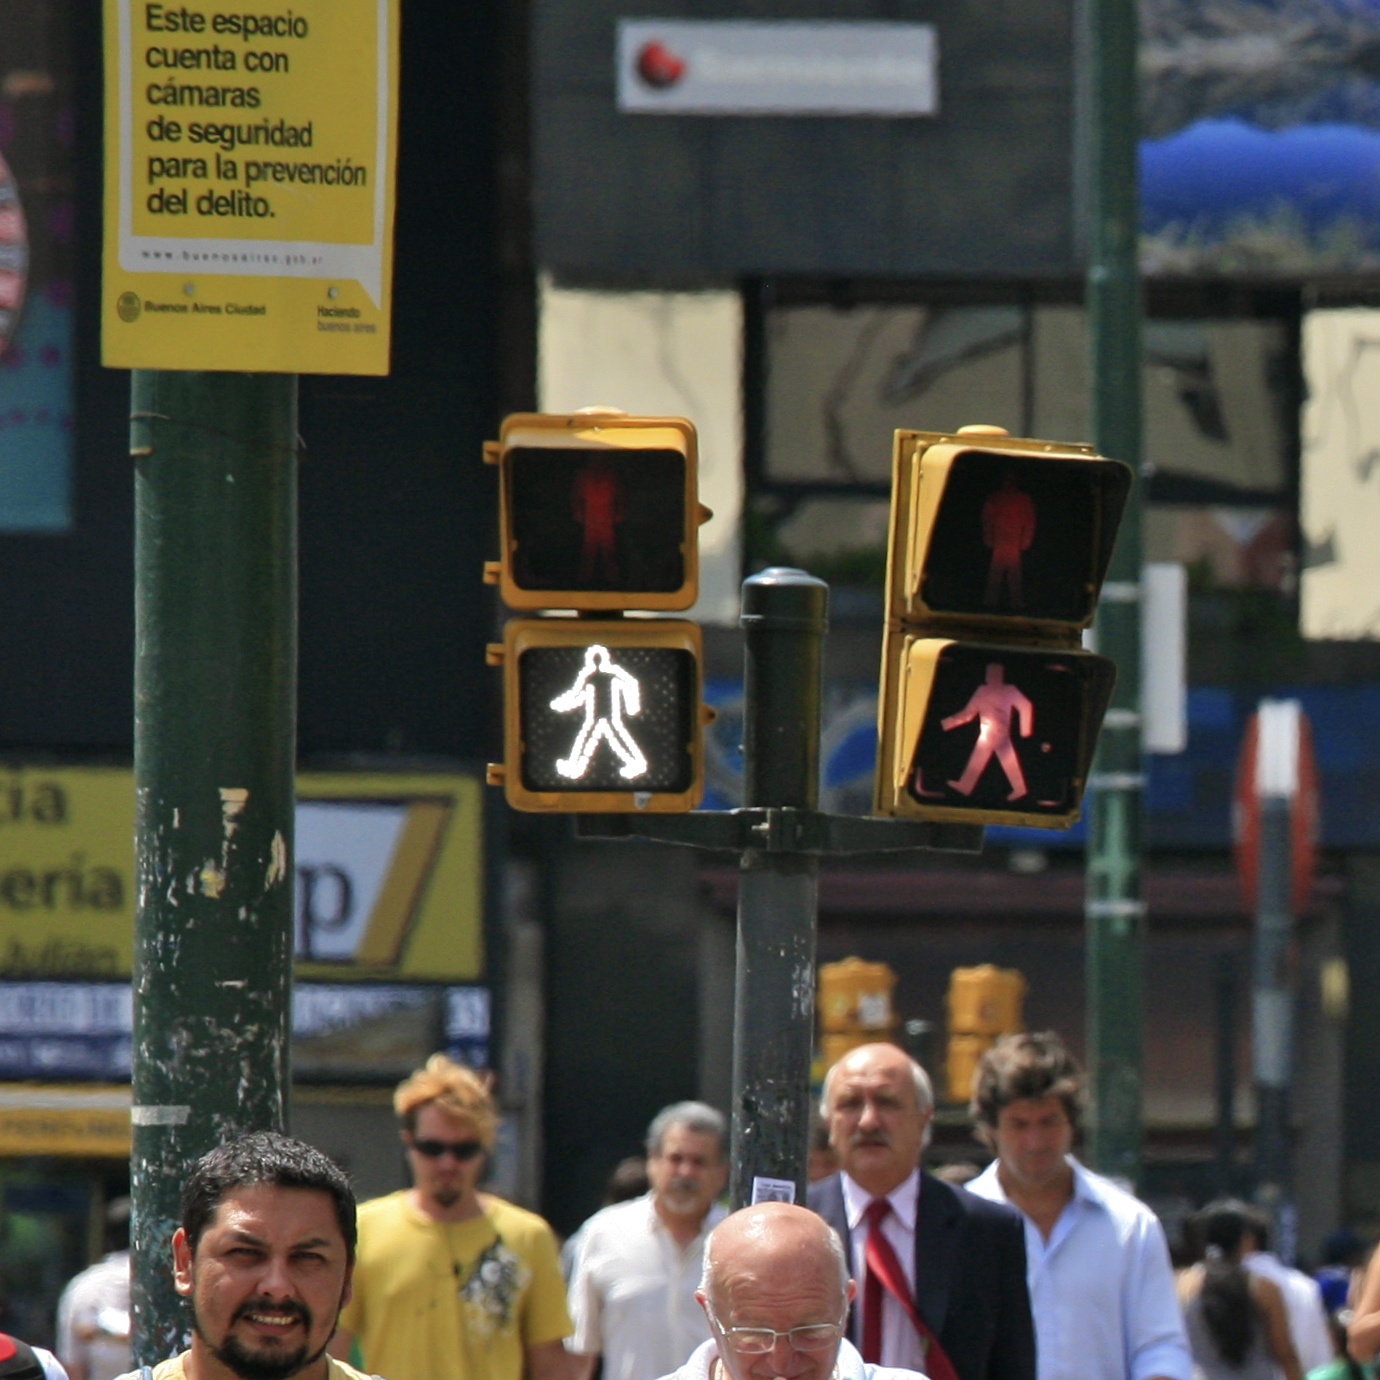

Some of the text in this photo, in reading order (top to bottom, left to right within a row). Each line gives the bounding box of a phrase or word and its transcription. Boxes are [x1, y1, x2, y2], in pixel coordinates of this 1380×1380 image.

[145, 3, 309, 42] Este espacio
[145, 45, 289, 73] cuenta con
[146, 77, 261, 108] cámaras
[146, 115, 313, 151] de seguridad
[147, 152, 367, 188] para la prevención
[146, 187, 276, 218] del delito.
[144, 301, 267, 316] Buenos Aires Ciudad
